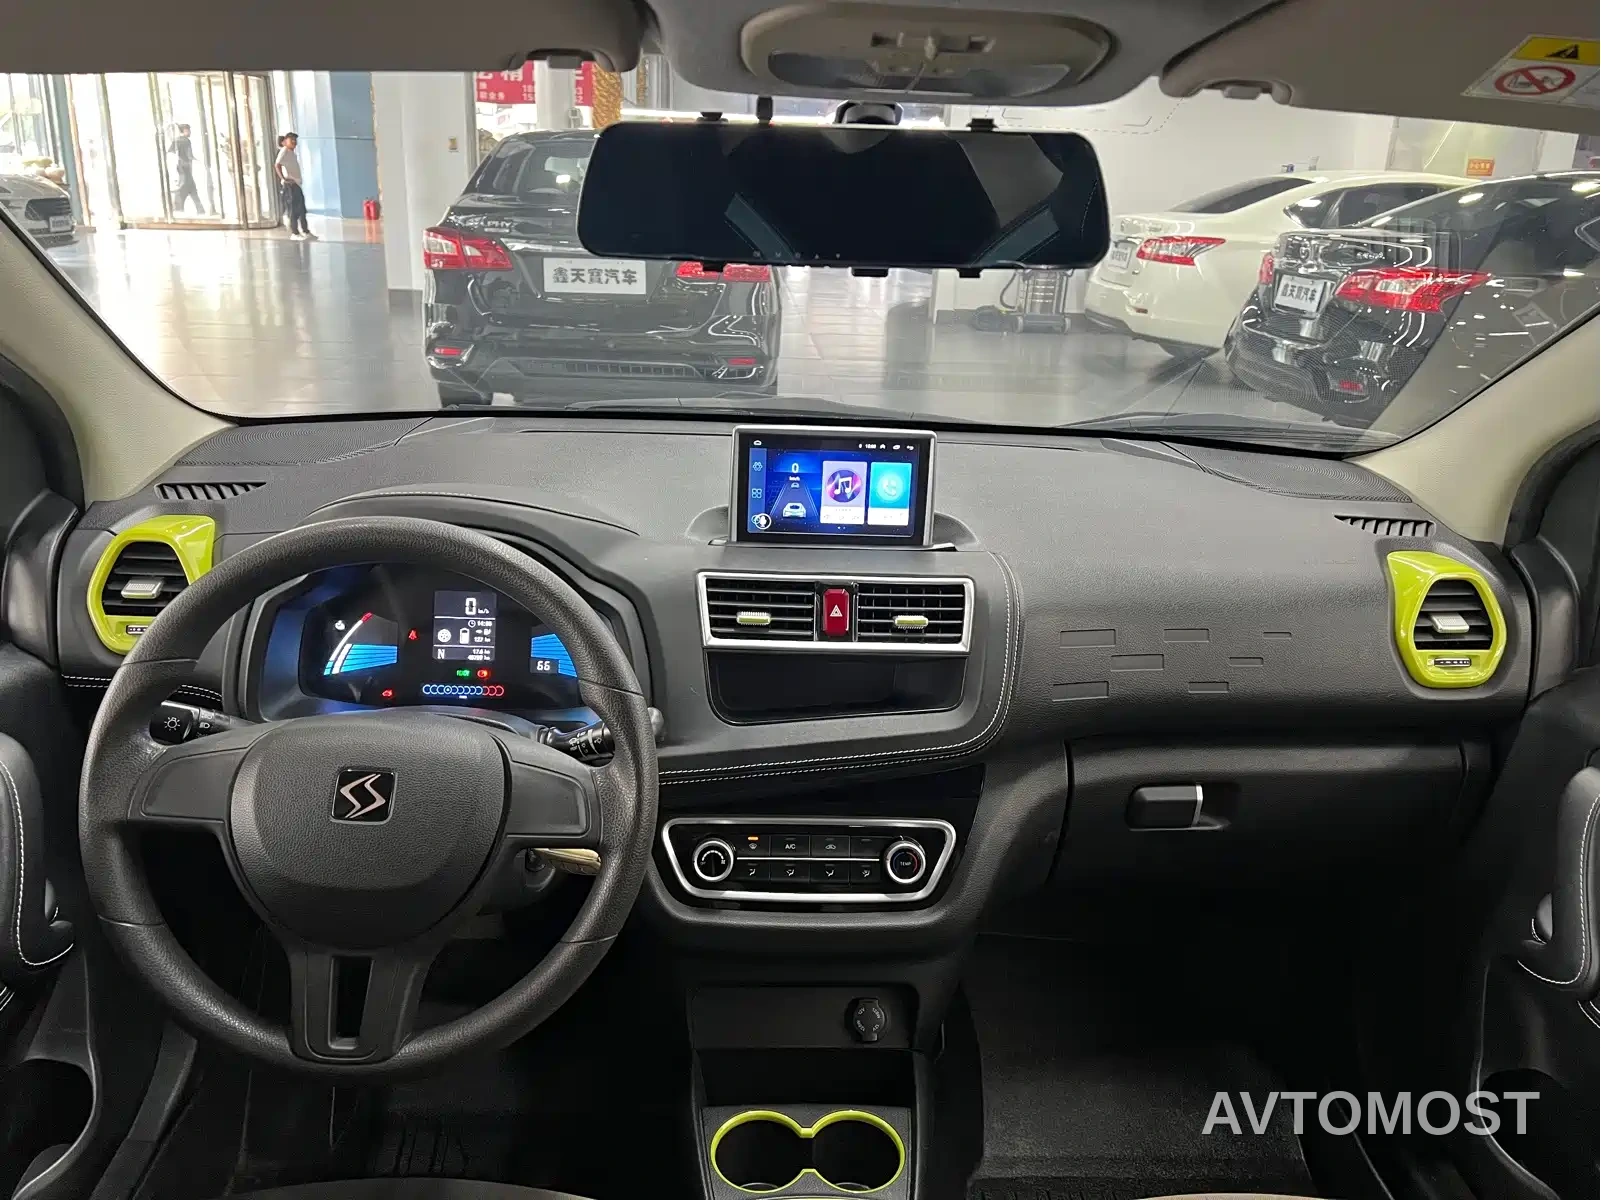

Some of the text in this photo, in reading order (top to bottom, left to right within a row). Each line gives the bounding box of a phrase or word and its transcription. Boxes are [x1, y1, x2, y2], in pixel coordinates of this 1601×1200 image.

[791, 462, 800, 474] 0
[465, 597, 477, 616] 0
[437, 648, 445, 660] N
